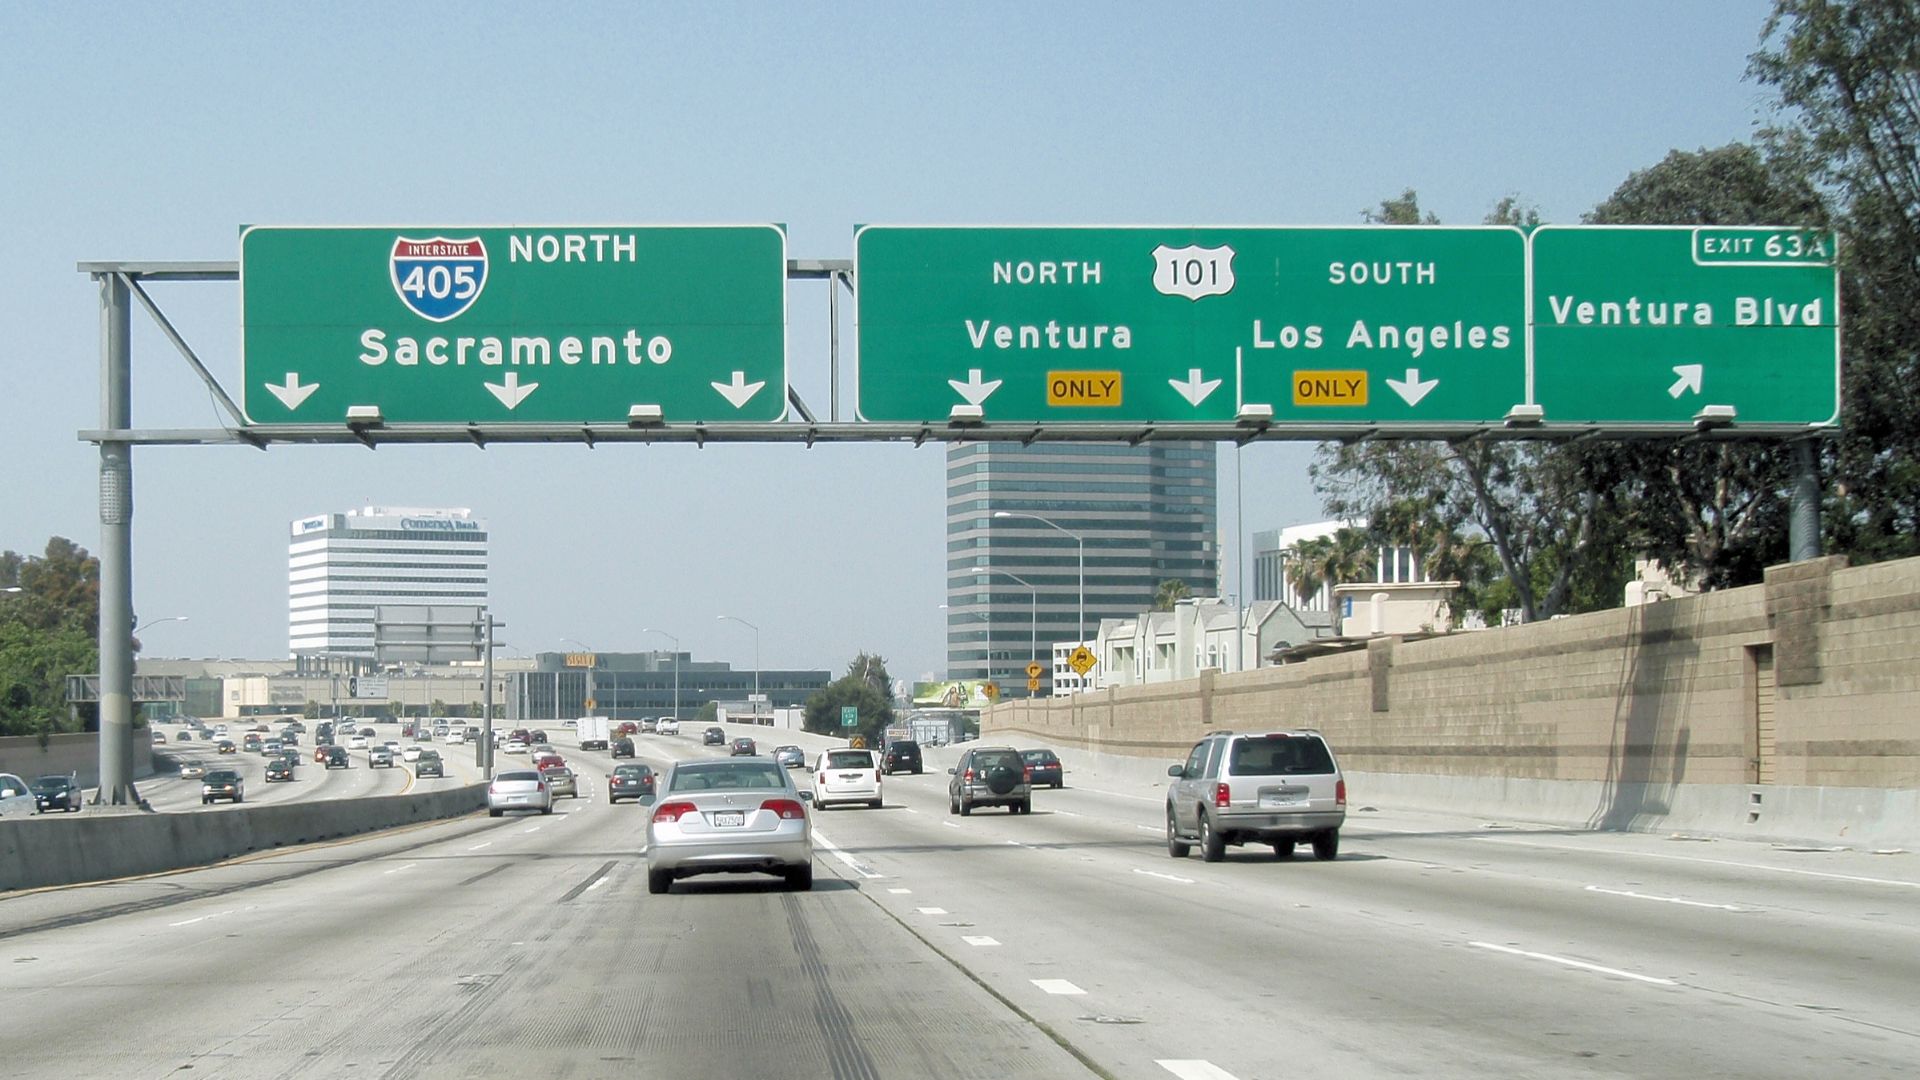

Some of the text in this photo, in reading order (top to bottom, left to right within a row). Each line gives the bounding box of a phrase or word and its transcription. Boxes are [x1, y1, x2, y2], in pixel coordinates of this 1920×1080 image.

[408, 245, 470, 256] INTERSTATE
[510, 235, 635, 262] NORTH
[1705, 235, 1825, 256] EXIT 63A
[402, 265, 477, 299] 405
[994, 262, 1100, 284] NORTH
[1171, 260, 1217, 285] 101
[1329, 262, 1434, 284] SOUTH
[1549, 296, 1820, 325] Ventura Blvd
[965, 320, 1130, 348] Ventura
[1254, 320, 1509, 357] Los Angeles
[360, 329, 671, 365] Sacramento
[1053, 380, 1116, 397] ONLY
[1298, 380, 1361, 397] ONLY
[456, 520, 479, 530] Bank
